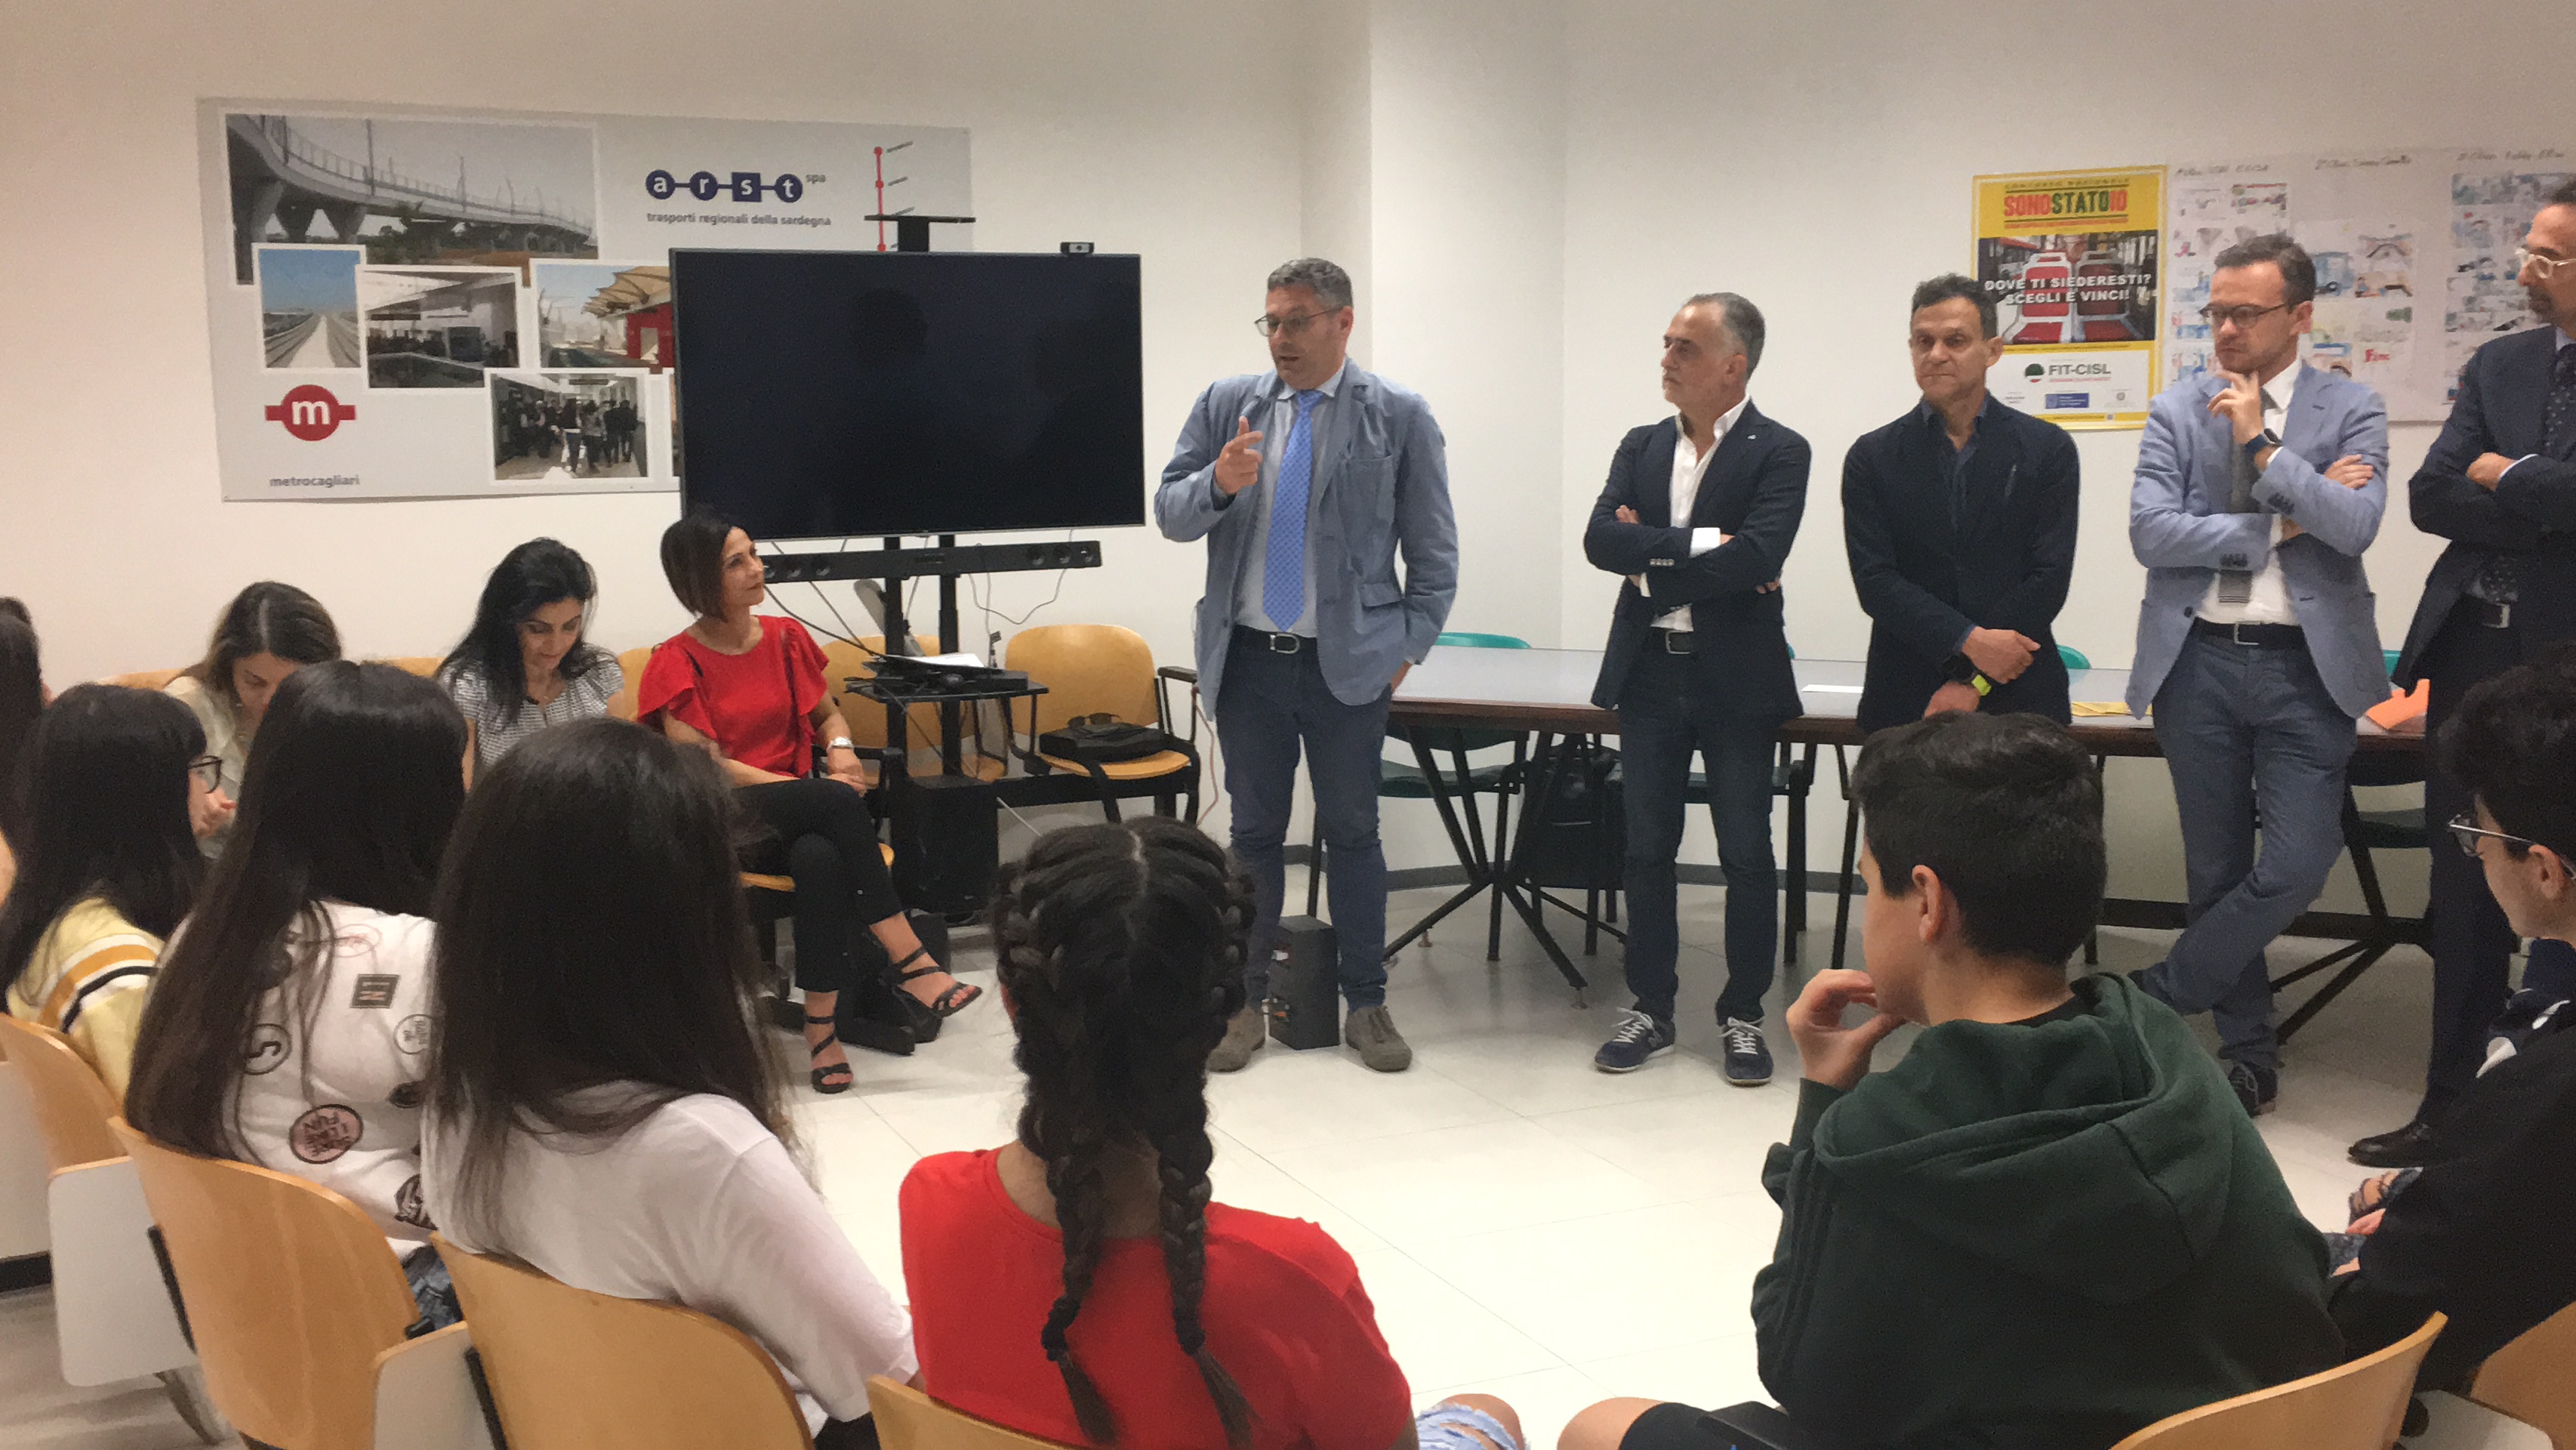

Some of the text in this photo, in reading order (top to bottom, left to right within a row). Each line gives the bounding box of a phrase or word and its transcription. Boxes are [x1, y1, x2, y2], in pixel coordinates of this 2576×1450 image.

[806, 174, 826, 184] spa
[647, 212, 831, 227] trasporti regionali della sardegna
[1984, 273, 2152, 291] DOVE TI SIEDERESTI?
[2005, 292, 2060, 304] SCEGLI
[2080, 290, 2130, 302] VINCI!
[2048, 363, 2112, 376] FIT-CISL
[291, 401, 331, 425] m
[270, 474, 360, 489] metrocagliari
